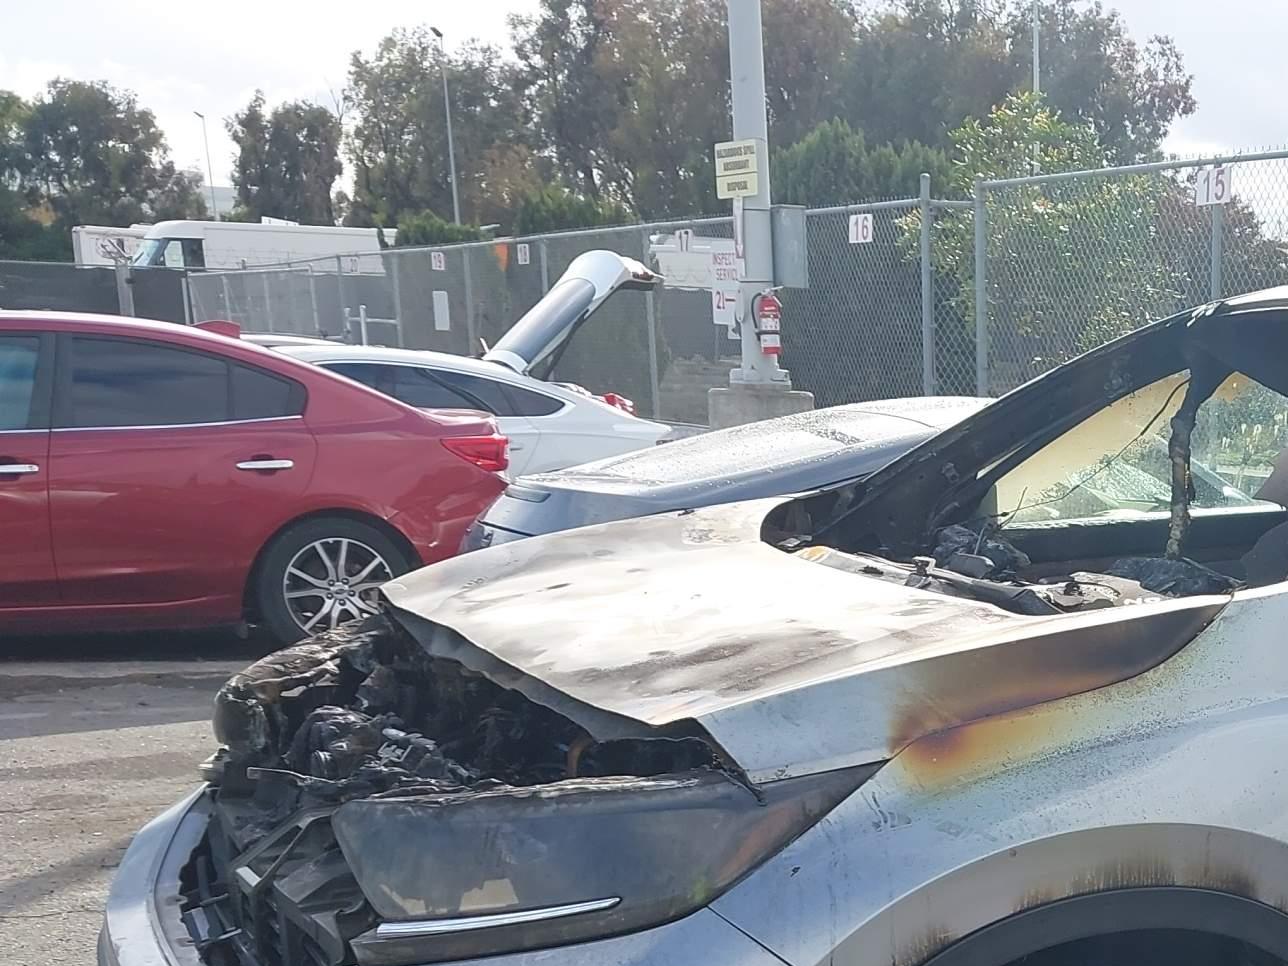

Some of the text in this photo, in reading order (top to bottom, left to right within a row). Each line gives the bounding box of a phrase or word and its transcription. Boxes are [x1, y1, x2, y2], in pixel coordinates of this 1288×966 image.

[1203, 168, 1226, 203] 15
[678, 230, 689, 252] 17
[854, 215, 870, 241] 16
